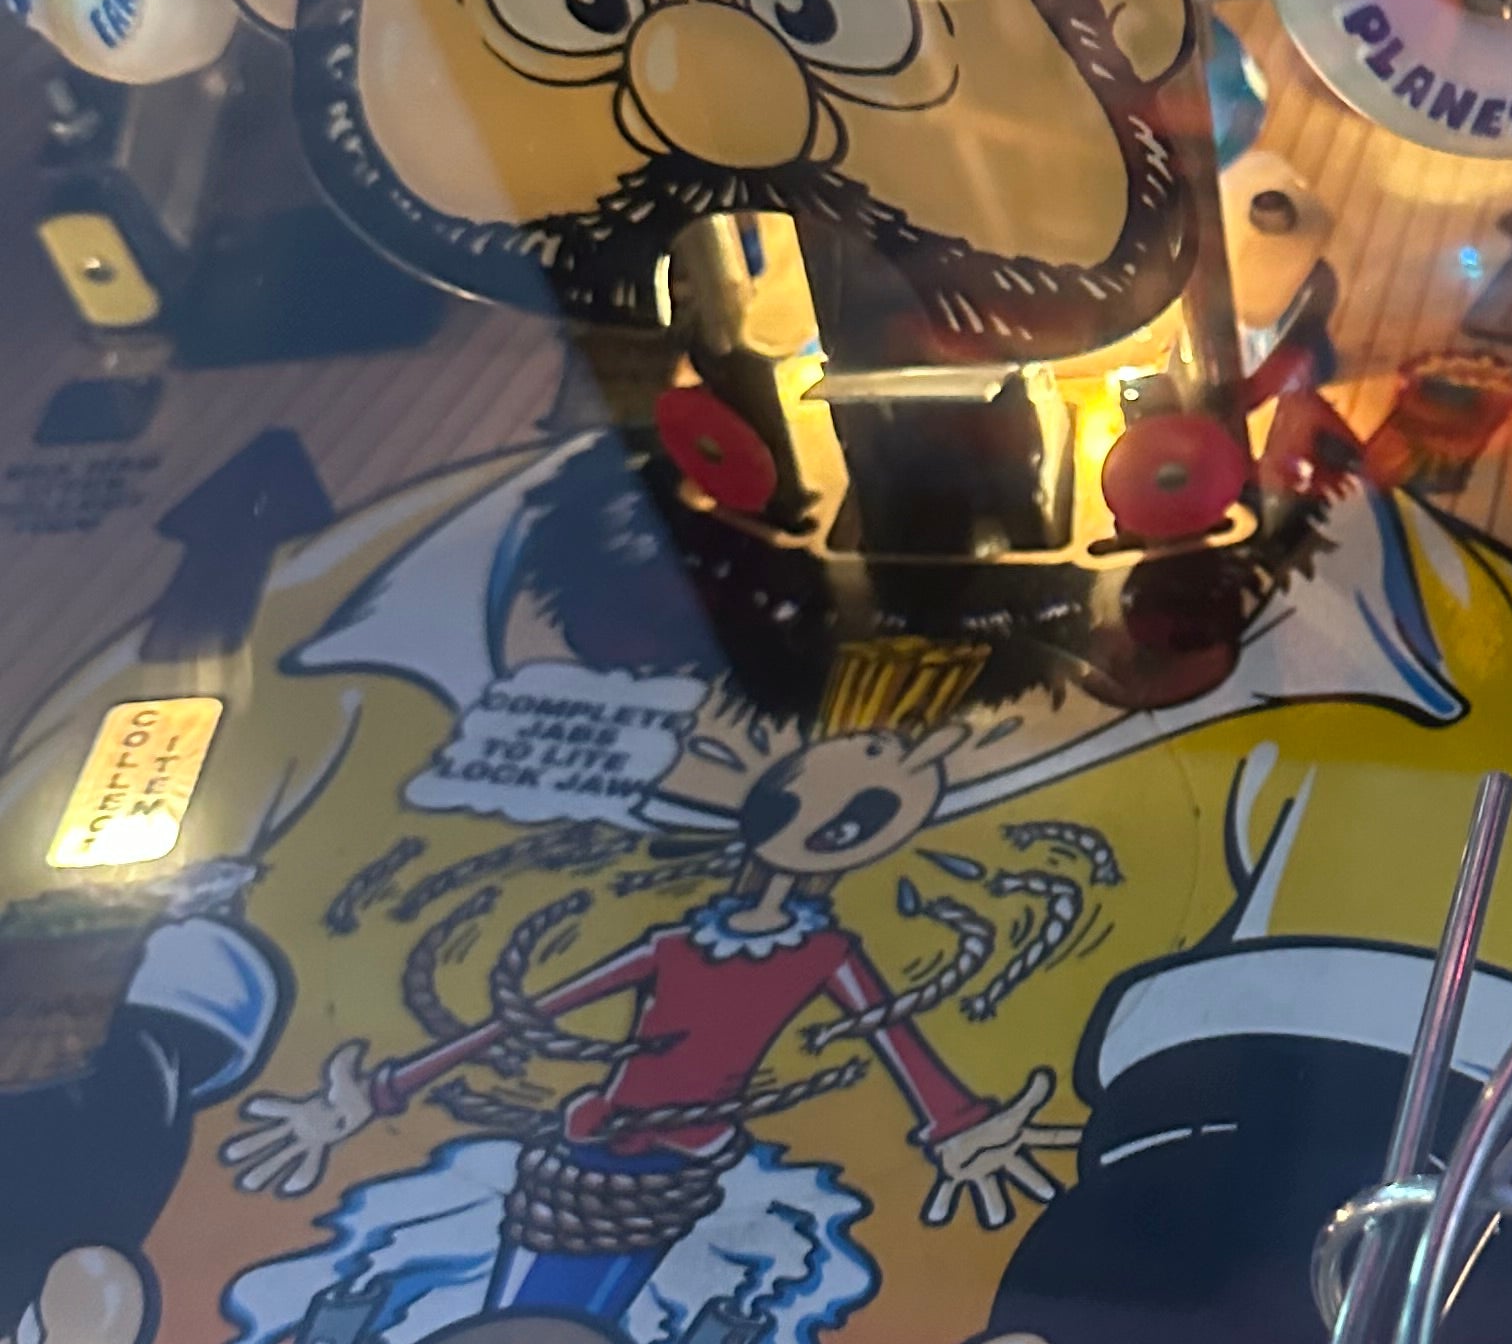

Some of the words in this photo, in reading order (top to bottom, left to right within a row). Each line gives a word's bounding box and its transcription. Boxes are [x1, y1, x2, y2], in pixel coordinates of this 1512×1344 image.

[484, 737, 534, 761] TO
[541, 746, 631, 773] LITE
[128, 735, 181, 817] ITEM
[553, 772, 648, 798] JAW
